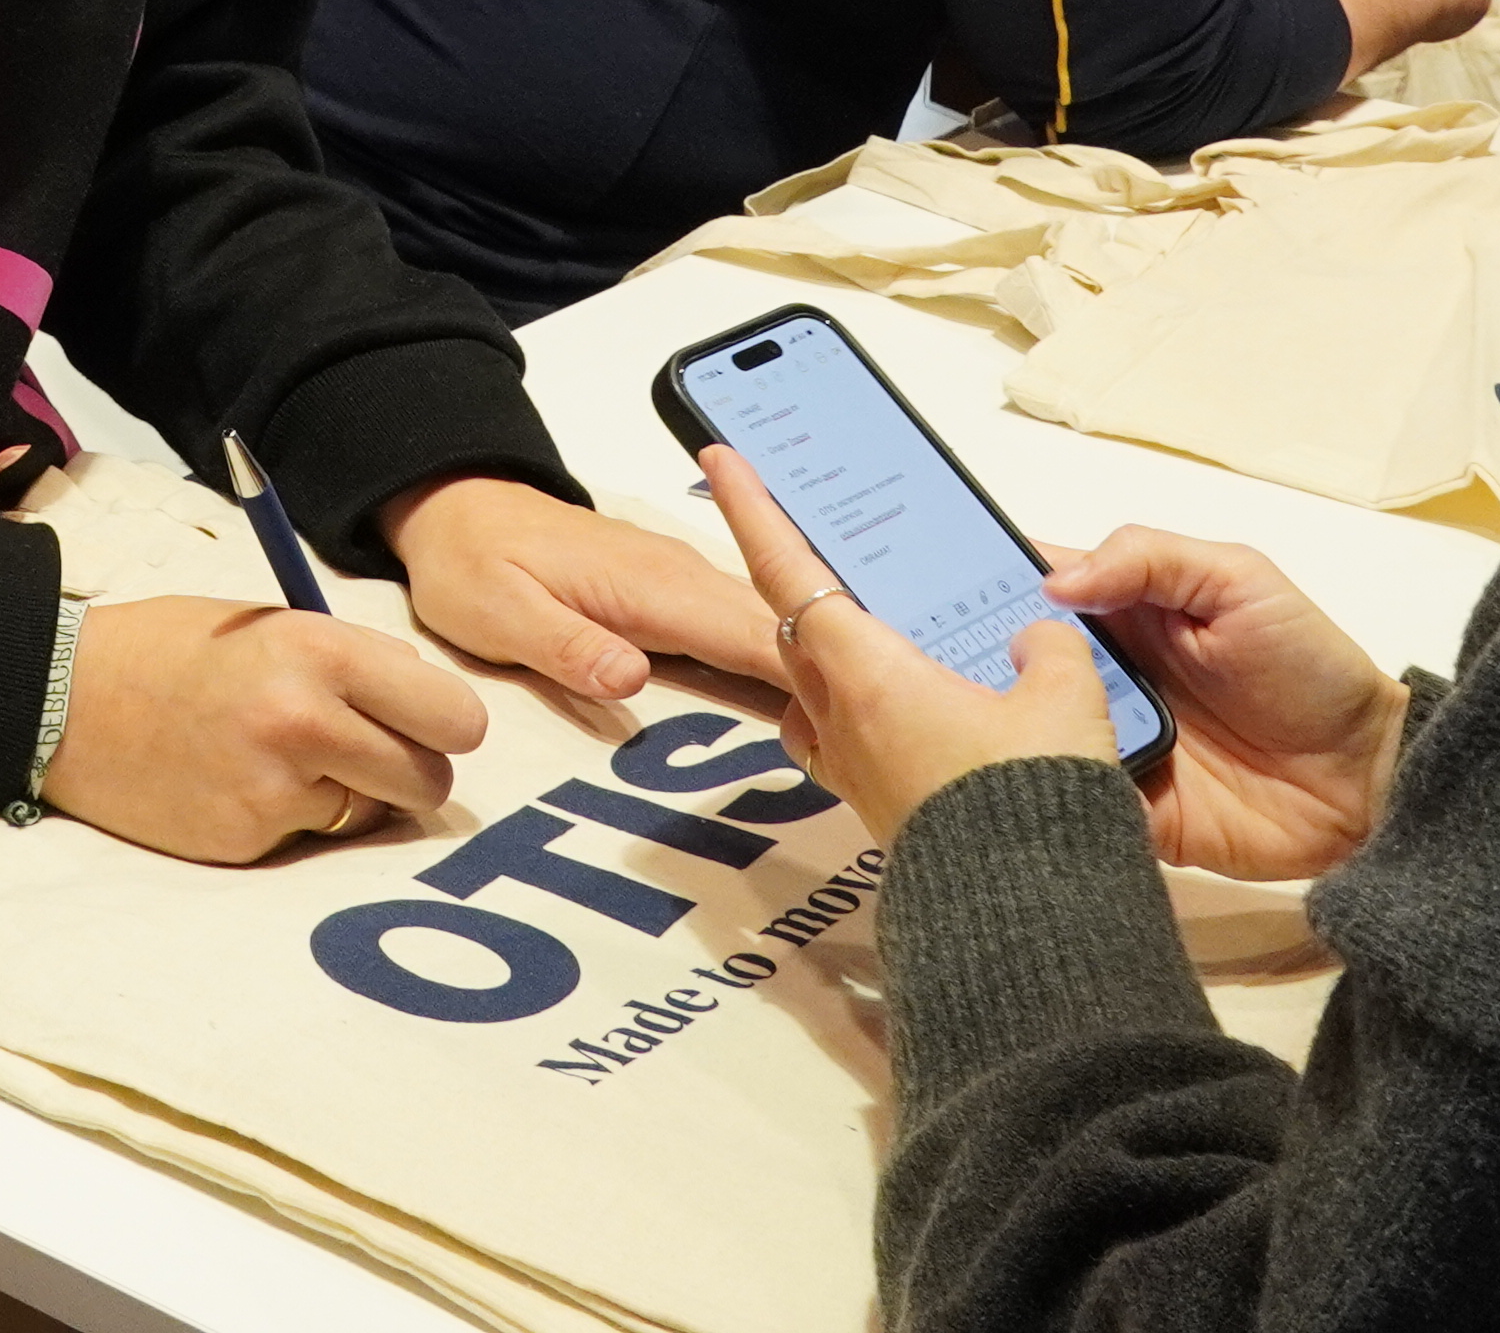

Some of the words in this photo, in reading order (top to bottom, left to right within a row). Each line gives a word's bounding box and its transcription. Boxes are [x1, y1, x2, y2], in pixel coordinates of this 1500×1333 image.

[309, 710, 843, 1025] OTIS
[535, 988, 719, 1086] Made
[690, 953, 777, 989] to
[757, 848, 886, 949] move
